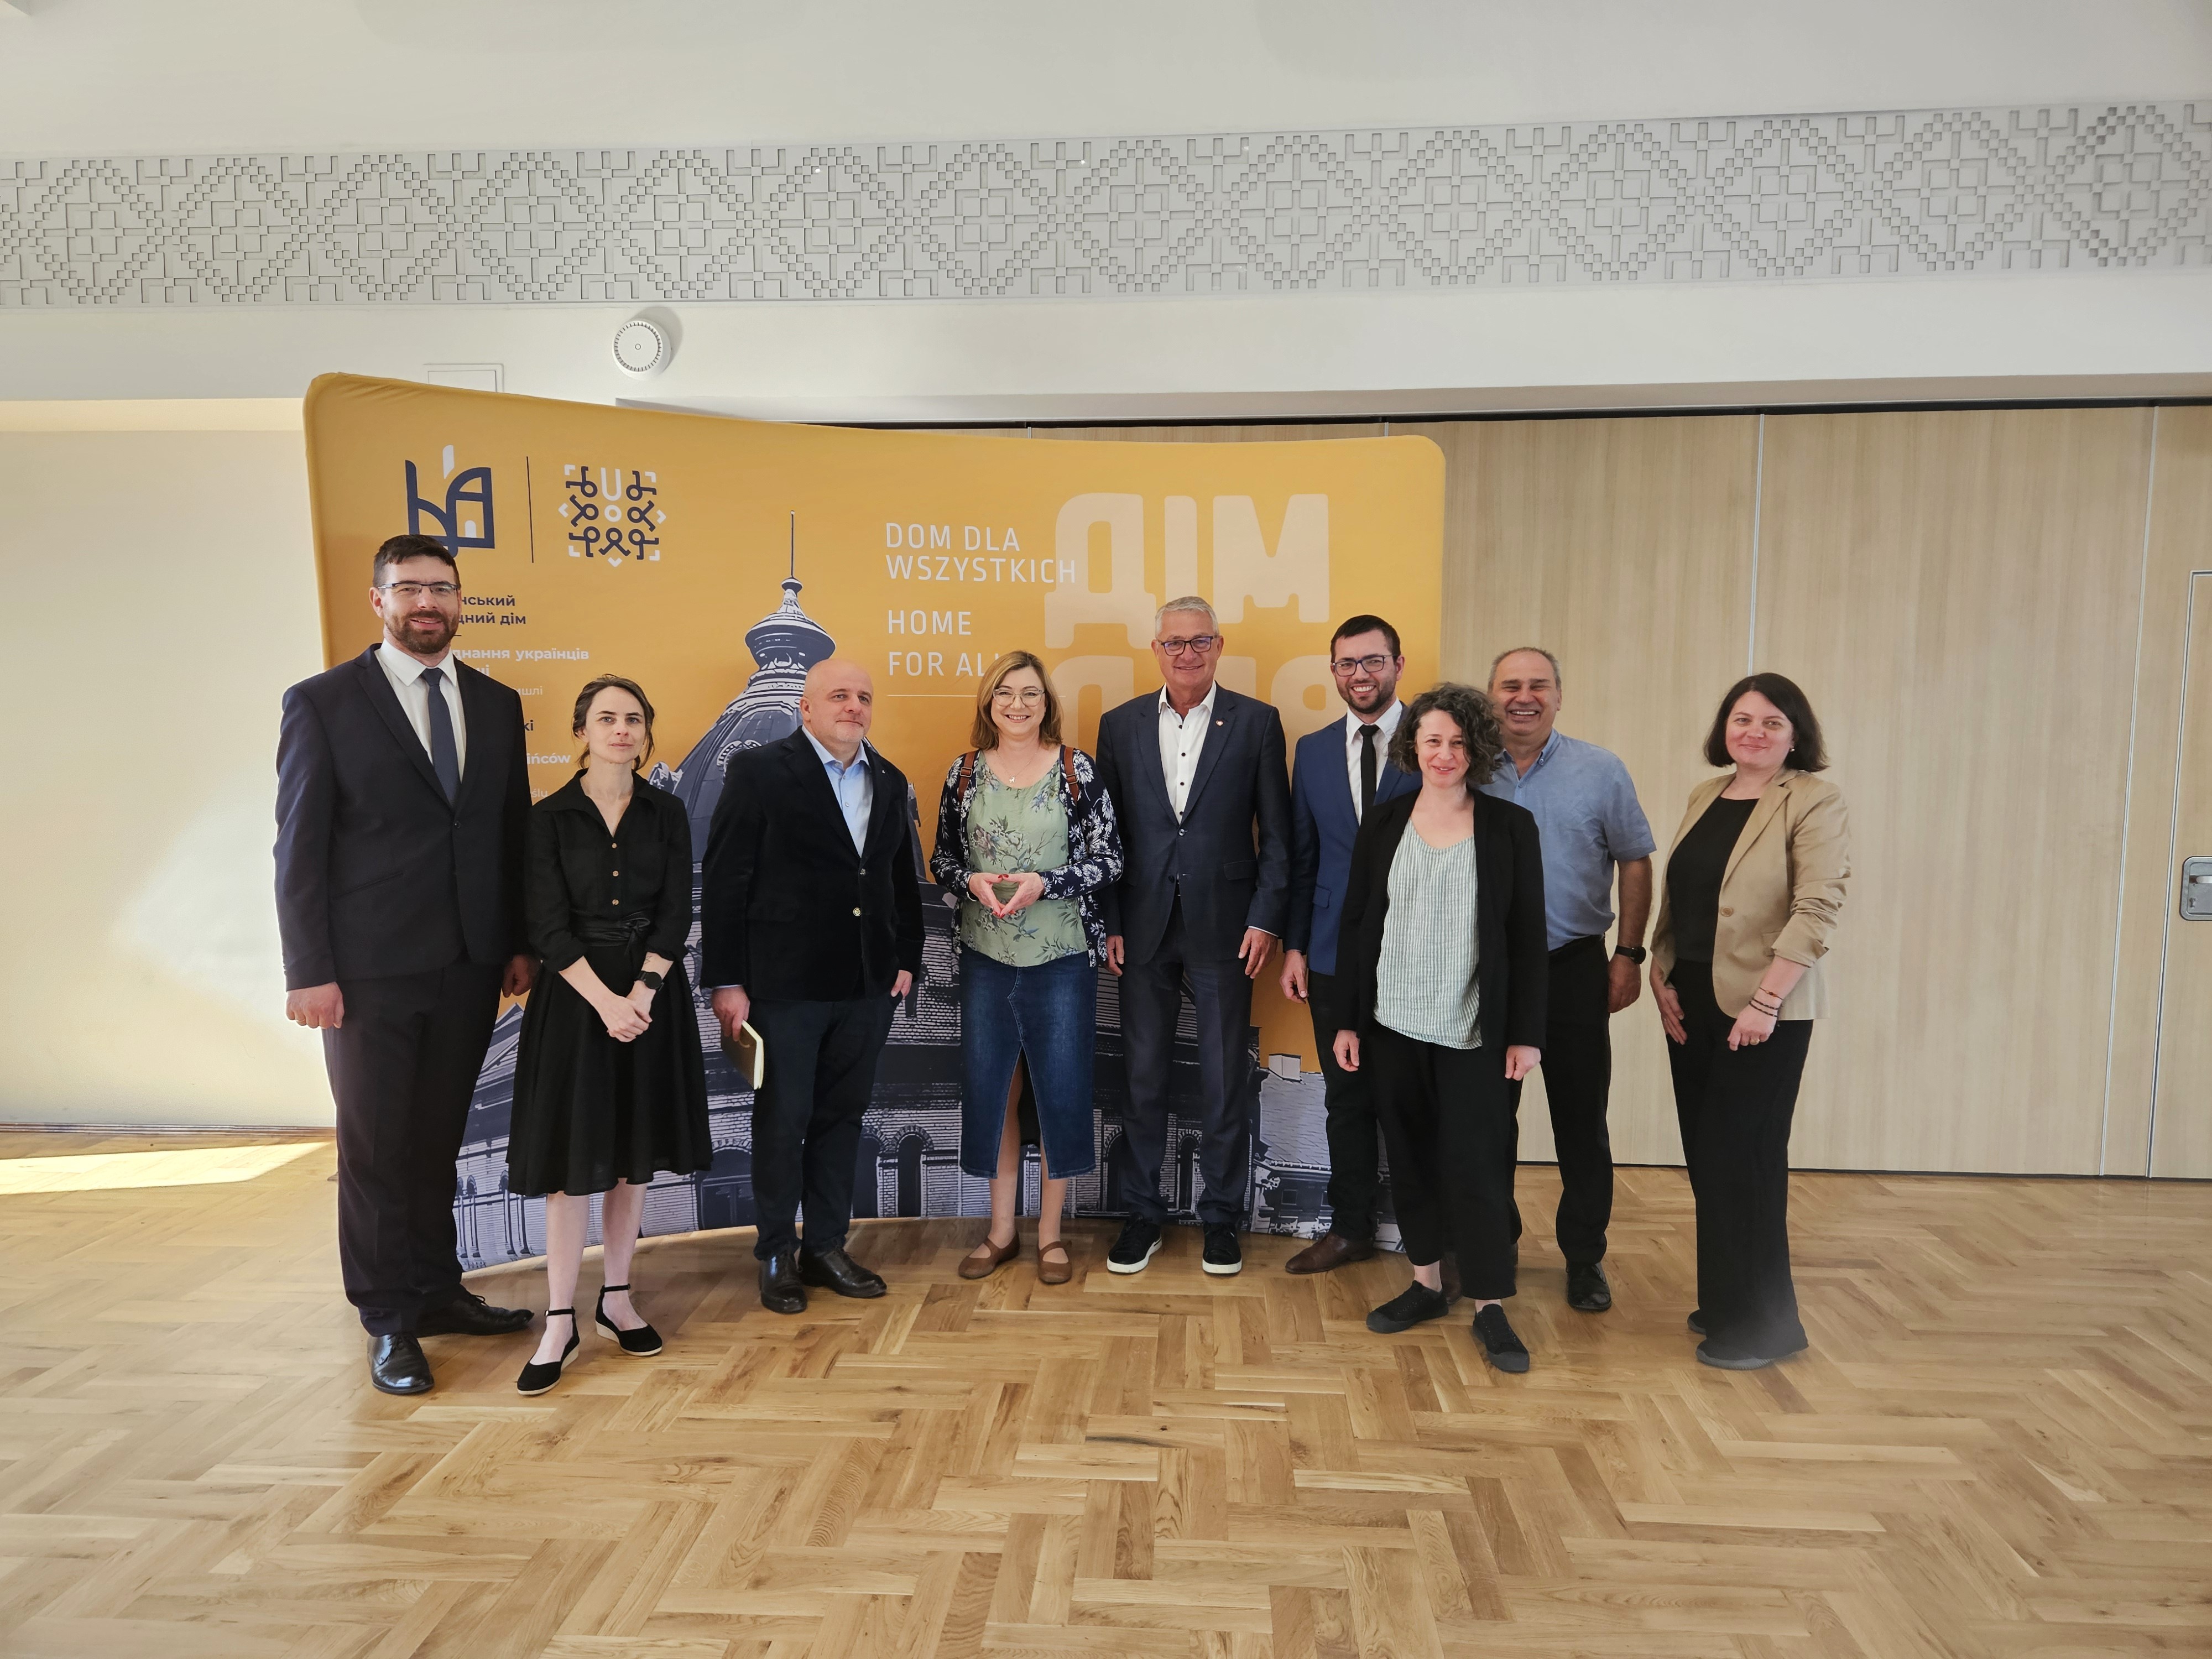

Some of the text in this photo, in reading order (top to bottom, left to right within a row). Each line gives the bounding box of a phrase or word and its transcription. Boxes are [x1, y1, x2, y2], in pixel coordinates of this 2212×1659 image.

[886, 523, 1020, 551] DOM DLA
[885, 555, 1076, 583] WSZYSTKICH
[461, 595, 515, 607] нський
[500, 612, 526, 625] дім
[888, 610, 972, 635] HOME
[452, 648, 589, 662] днання українців
[889, 651, 1000, 677] FOR AL
[526, 752, 571, 765] ińców
